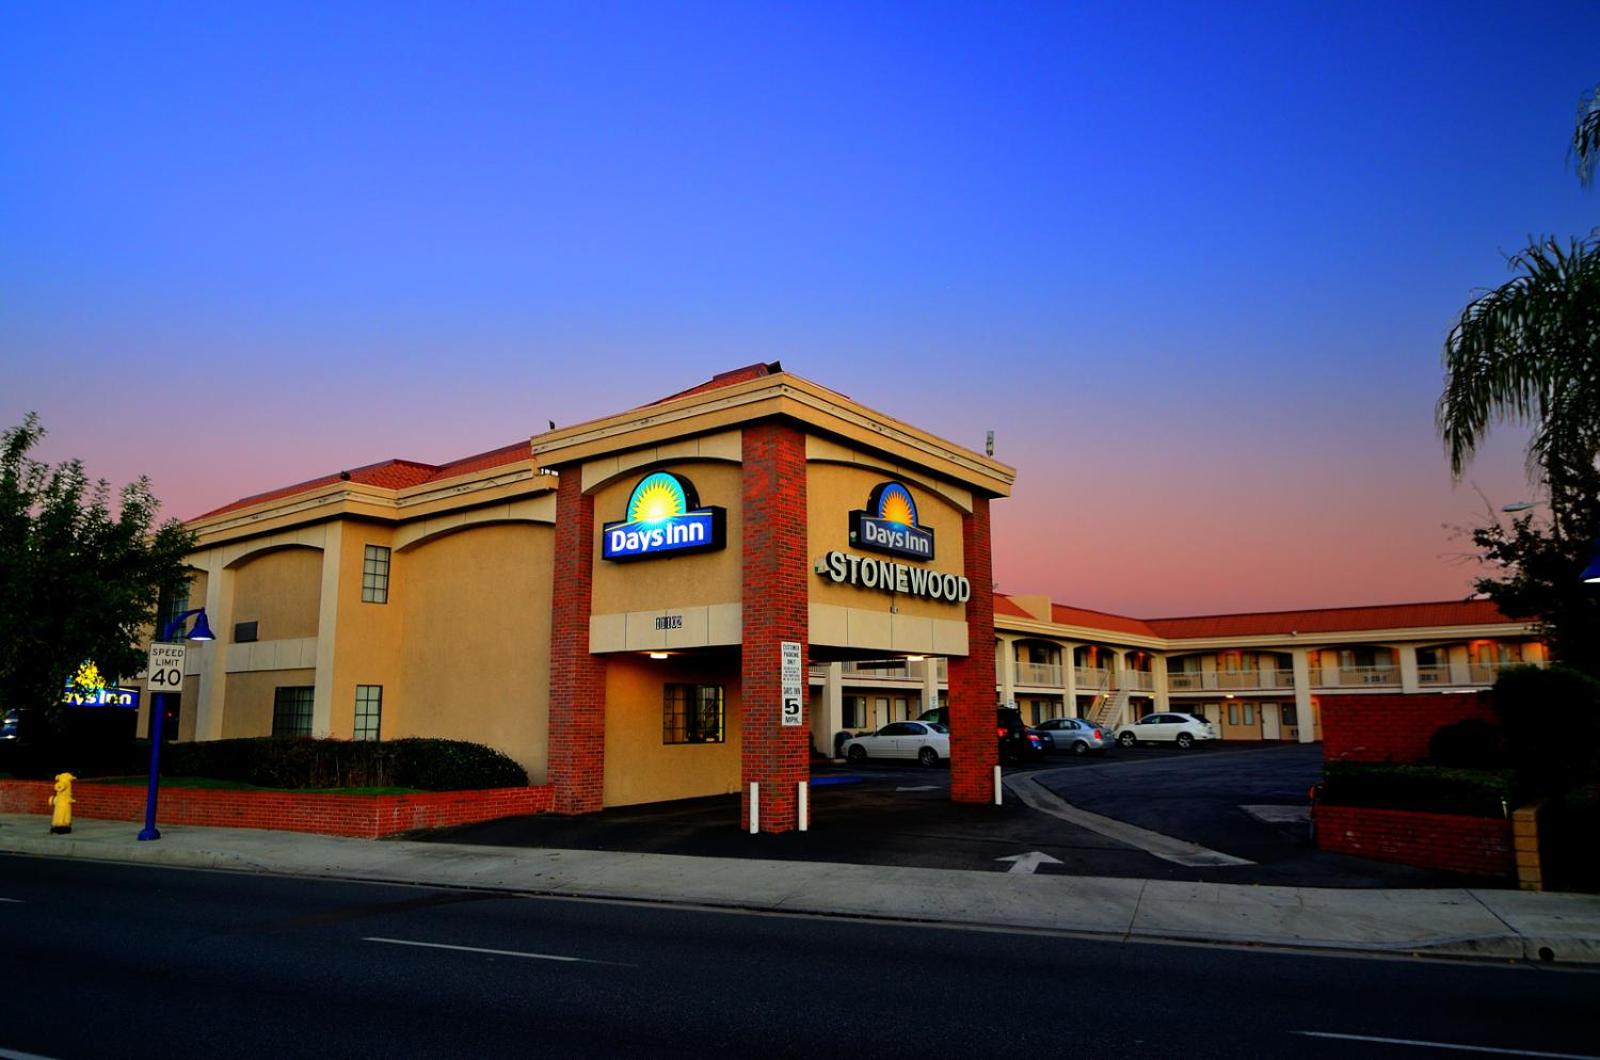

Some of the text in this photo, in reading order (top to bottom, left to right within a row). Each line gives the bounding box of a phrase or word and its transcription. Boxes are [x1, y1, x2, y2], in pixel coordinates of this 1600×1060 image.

[611, 522, 704, 552] Days Inn
[865, 521, 929, 553] Days Inn
[829, 551, 971, 603] STONEWOOD
[152, 647, 184, 657] SPEED
[155, 659, 179, 667] LIMIT
[151, 668, 182, 686] 40
[62, 689, 131, 706] ays Inn
[785, 698, 799, 715] 5
